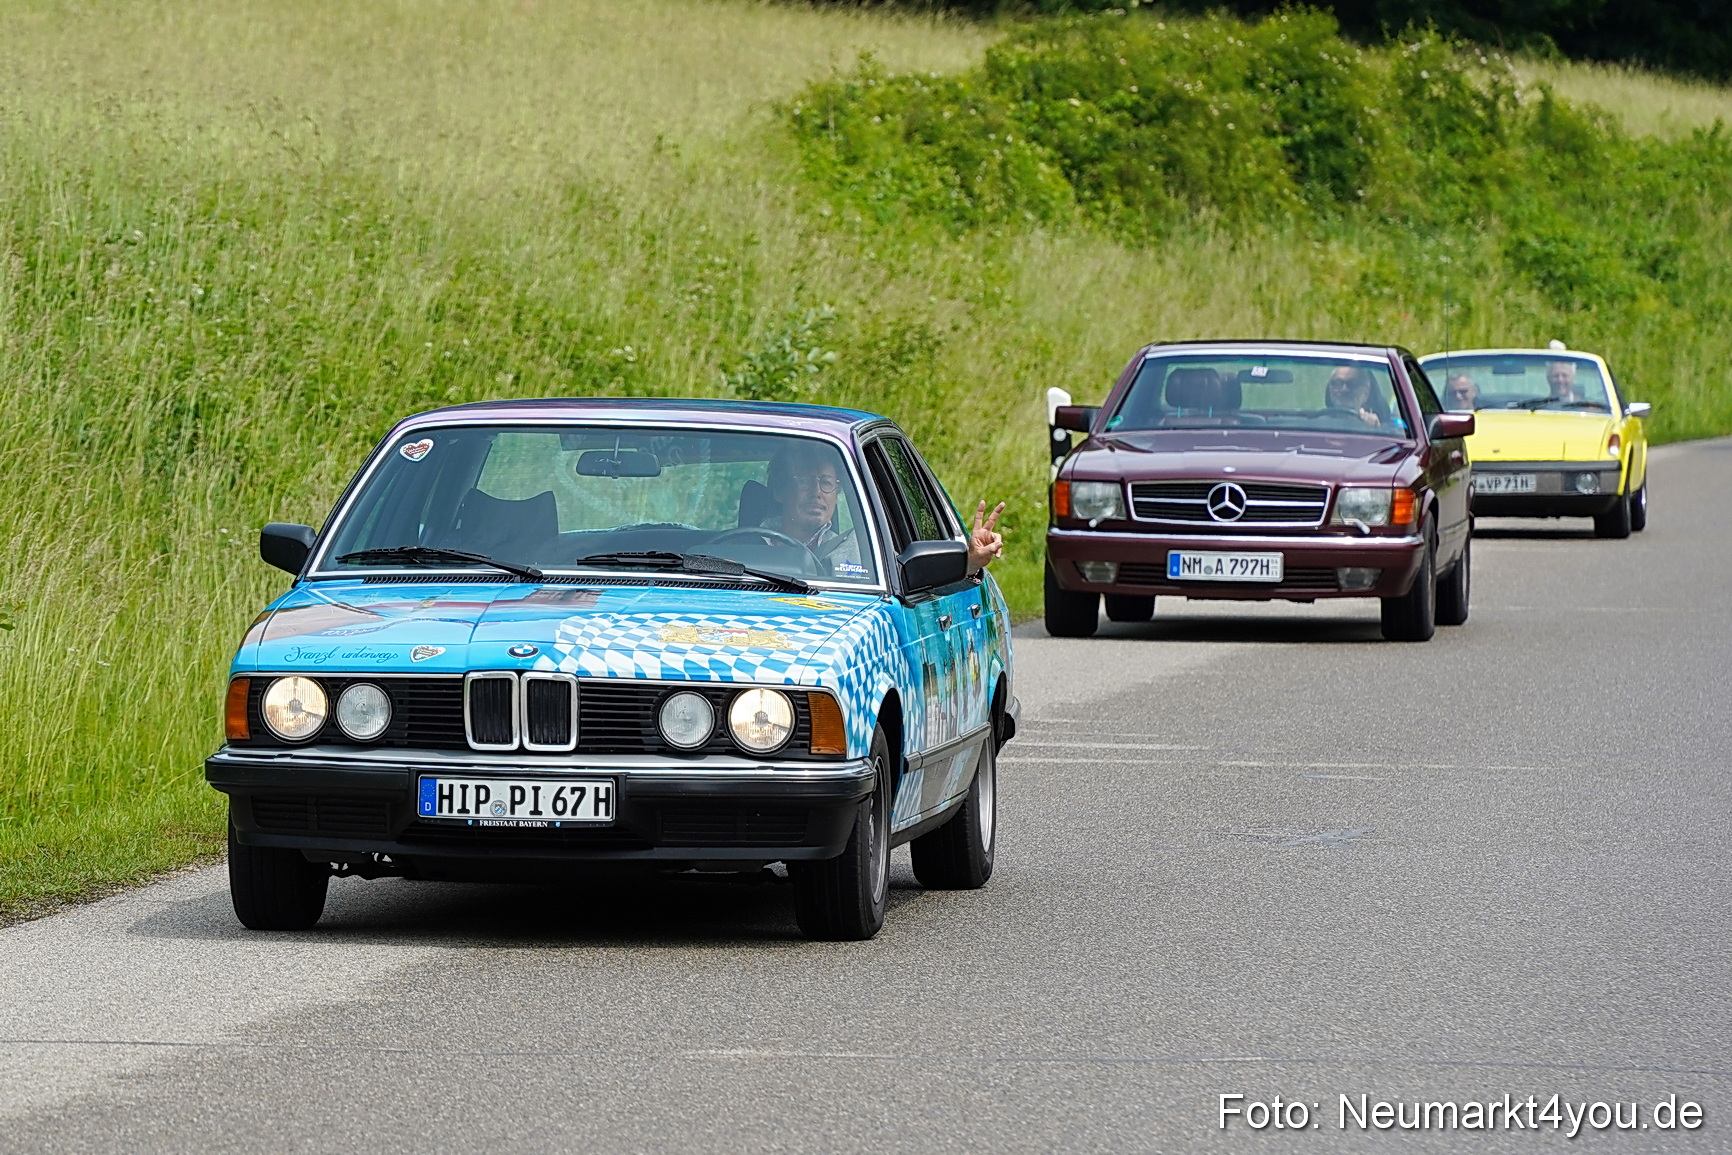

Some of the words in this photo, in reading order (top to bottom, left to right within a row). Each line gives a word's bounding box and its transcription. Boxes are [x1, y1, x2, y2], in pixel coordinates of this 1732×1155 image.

[1182, 557, 1202, 574] NM
[1215, 558, 1224, 574] A
[1230, 558, 1270, 576] 797H
[284, 645, 340, 664] Franzl
[342, 646, 399, 663] unterwegs
[424, 802, 432, 811] D
[438, 783, 491, 814] HIP
[509, 785, 544, 816] PI
[479, 819, 518, 828] FREISTAAT
